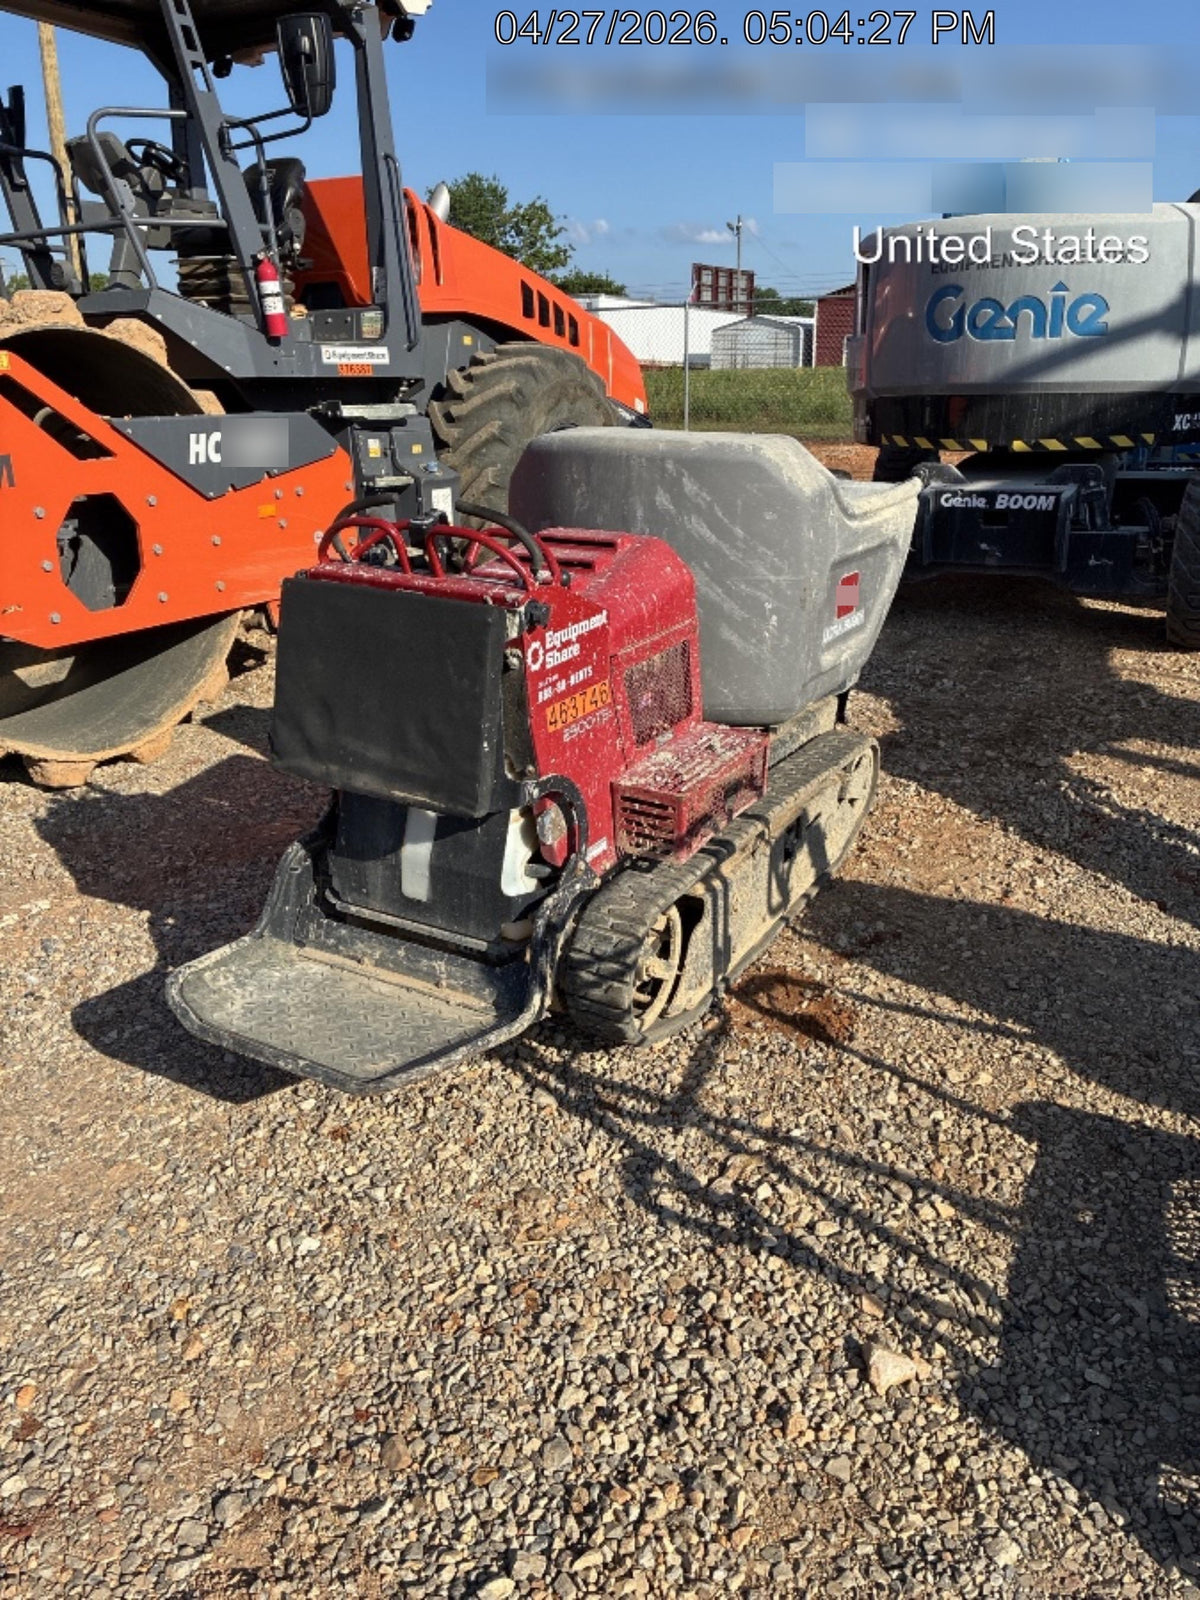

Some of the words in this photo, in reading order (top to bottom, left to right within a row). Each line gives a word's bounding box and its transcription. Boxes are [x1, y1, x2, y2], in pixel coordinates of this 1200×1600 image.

[926, 280, 1110, 343] Genie
[189, 431, 222, 464] HC
[940, 492, 986, 509] Genie
[995, 494, 1056, 511] BOOM
[545, 609, 608, 650] Equipment
[545, 643, 580, 669] Share
[549, 682, 609, 728] 463746
